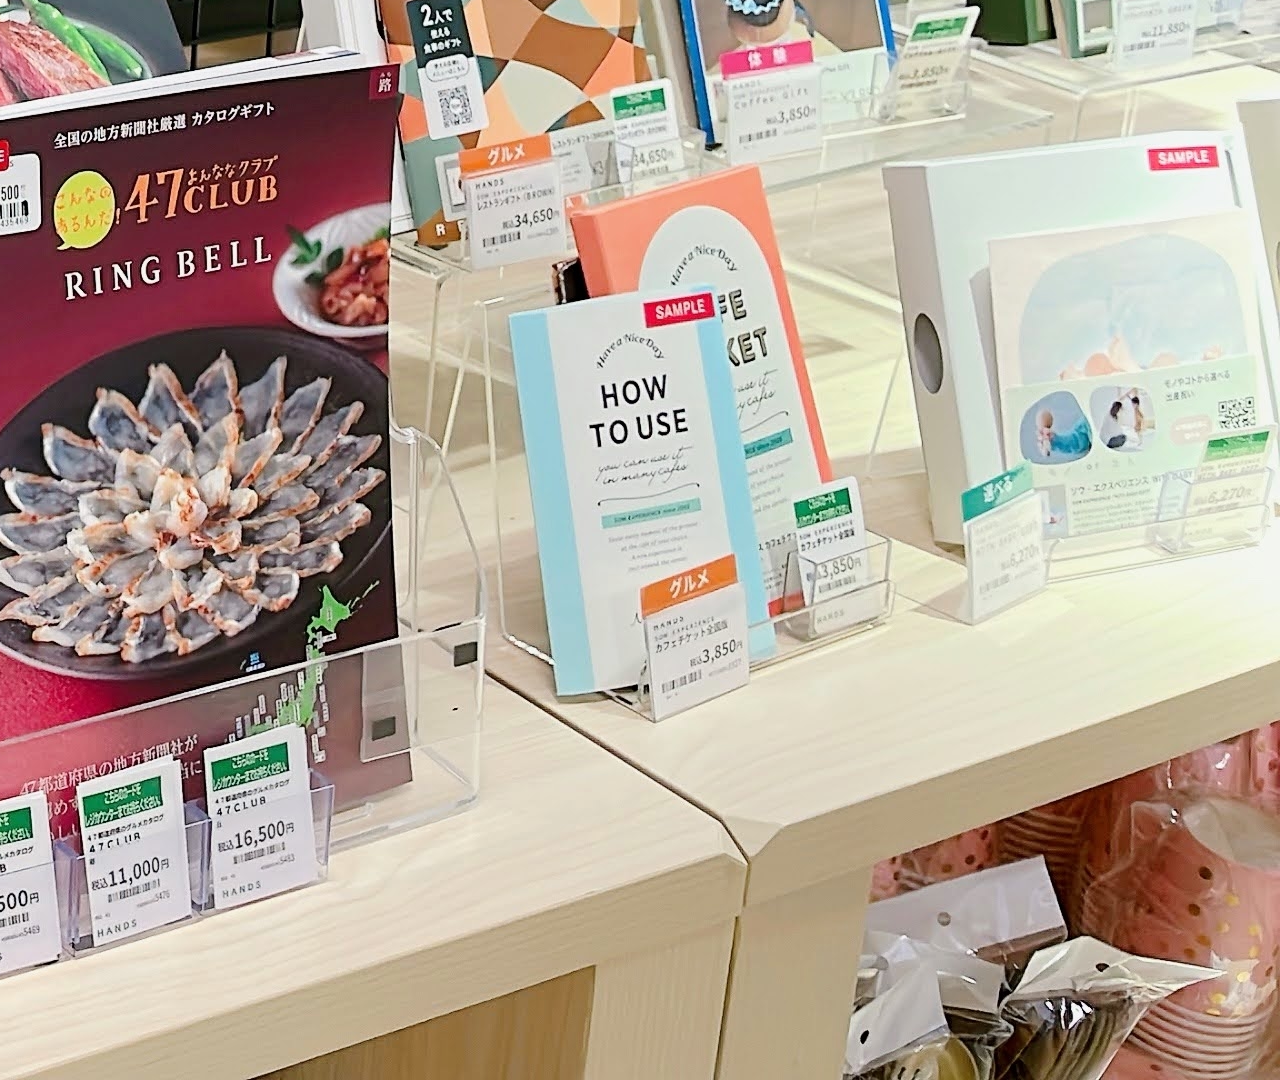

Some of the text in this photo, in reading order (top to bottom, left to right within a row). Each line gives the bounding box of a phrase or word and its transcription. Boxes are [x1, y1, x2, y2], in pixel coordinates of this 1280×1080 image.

[420, 3, 453, 27] 2人で
[53, 101, 276, 150] 全国の地方新聞社厳選 カタログギフト
[487, 145, 526, 165] グルメ
[1157, 150, 1211, 165] SAMPLE
[184, 176, 279, 215] CLUB
[475, 177, 505, 190] HANDS
[125, 169, 185, 224] 47
[63, 236, 272, 301] RING BELL
[716, 249, 739, 273] Day
[655, 298, 707, 320] SAMPLE
[596, 332, 666, 370] Have Nice Day
[600, 373, 668, 409] HOW
[589, 408, 689, 448] TO USE
[668, 568, 710, 599] グルメ
[216, 796, 266, 817] 47CLUB
[222, 880, 262, 899] HANDS
[97, 918, 138, 938] HANDS
